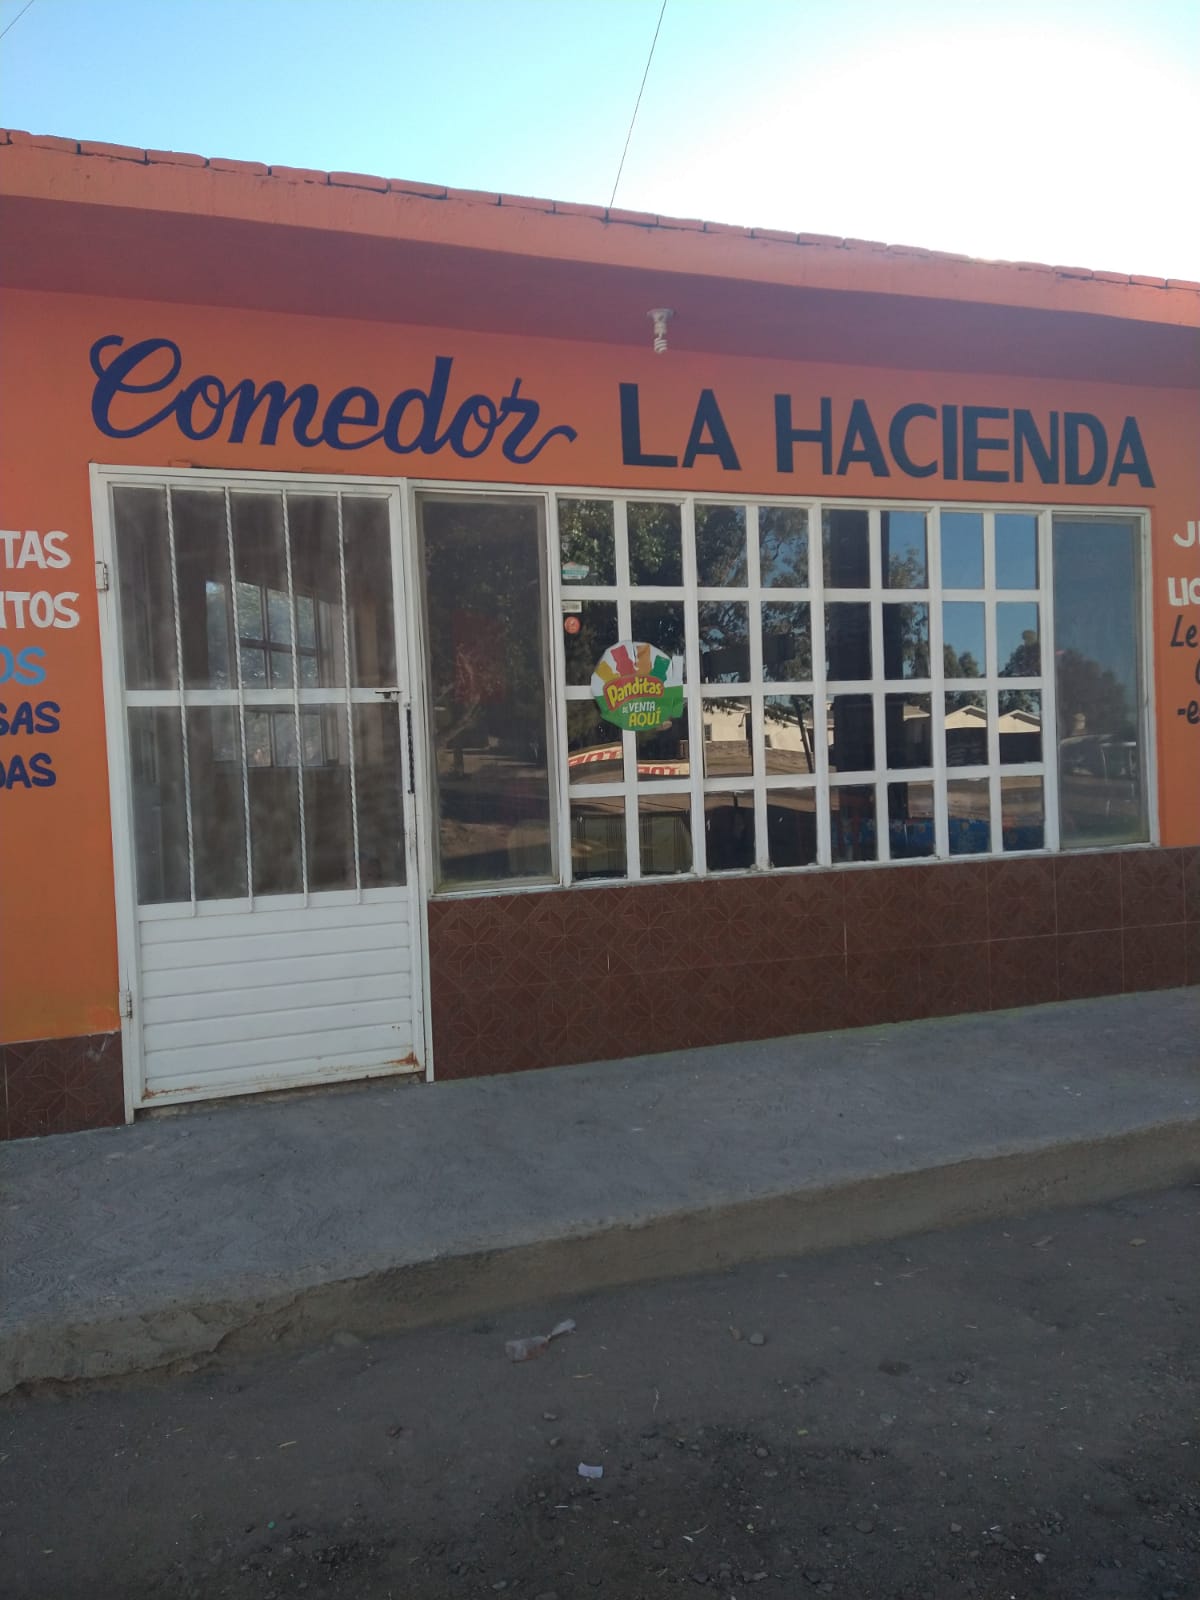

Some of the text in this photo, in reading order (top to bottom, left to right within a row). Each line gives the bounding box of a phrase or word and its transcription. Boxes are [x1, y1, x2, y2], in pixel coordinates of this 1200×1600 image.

[89, 335, 1156, 489] Comedor LA HACIENDA
[1173, 520, 1200, 547] J
[606, 676, 662, 708] Panditas
[628, 701, 656, 713] VENTA
[628, 706, 661, 728] AQUÍ
[0, 752, 56, 790] AS
